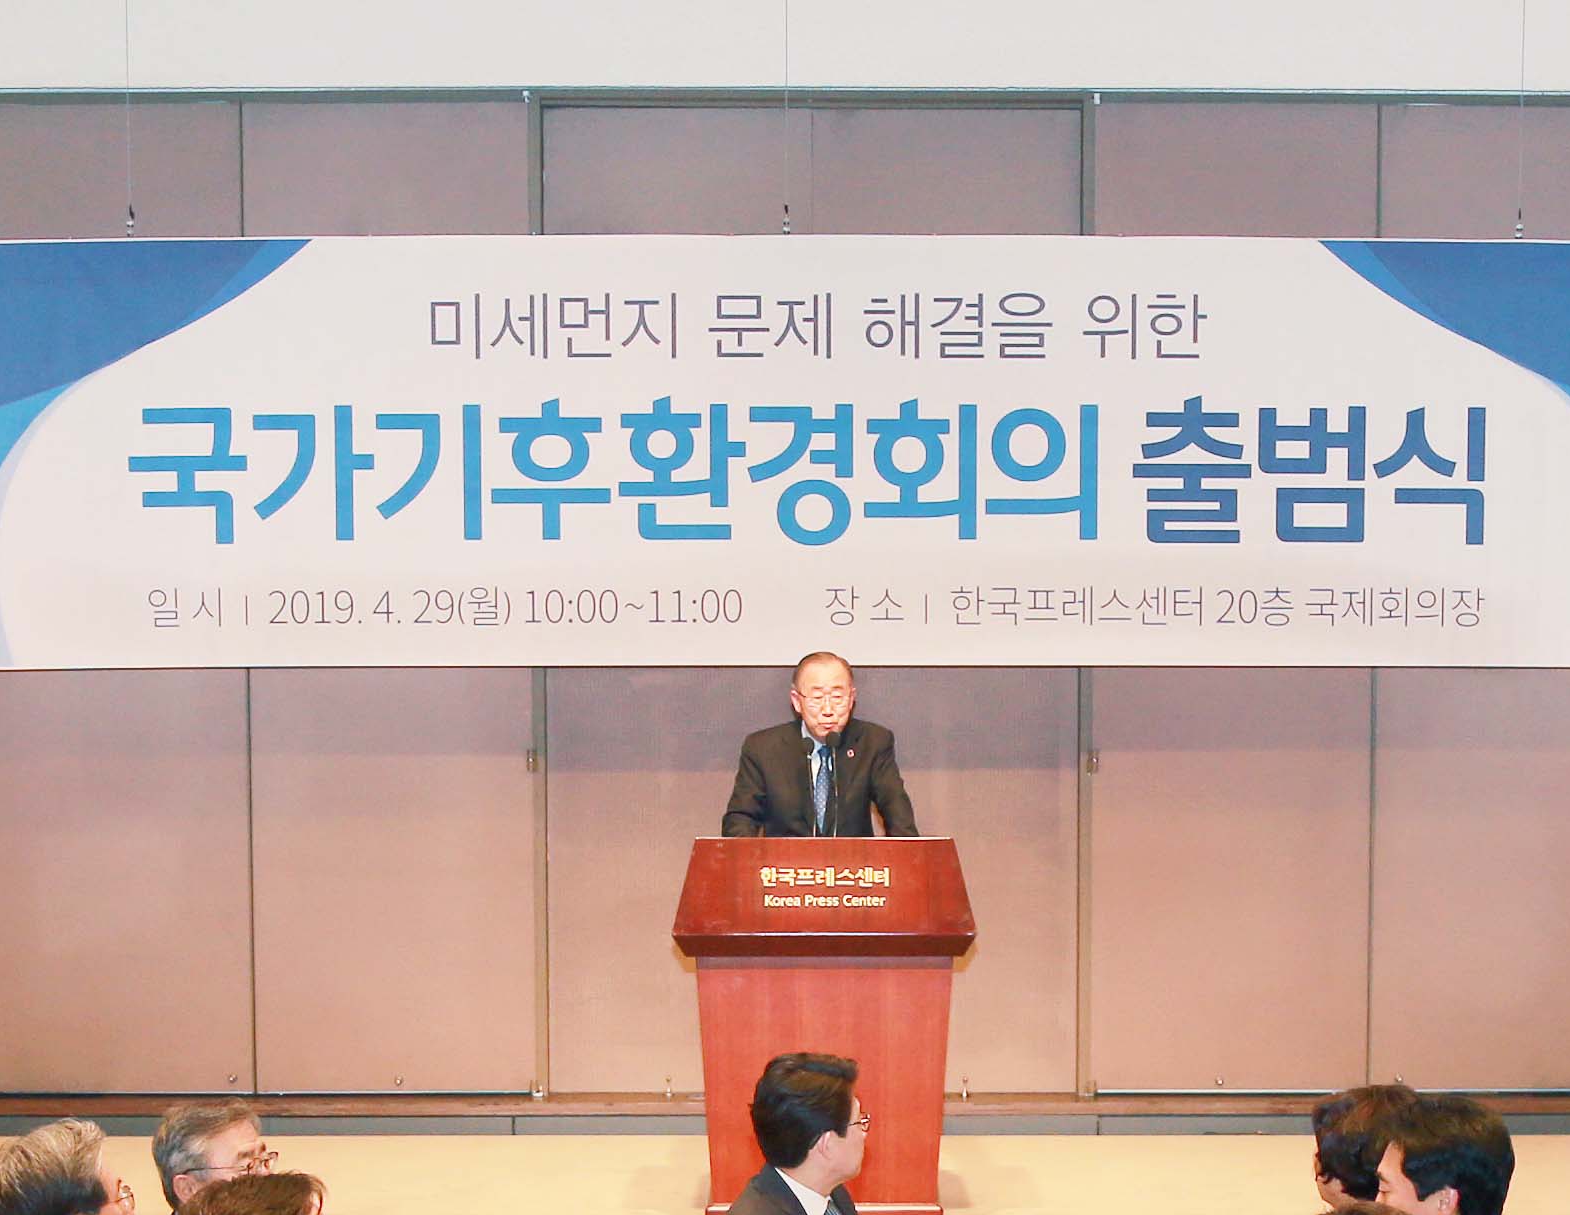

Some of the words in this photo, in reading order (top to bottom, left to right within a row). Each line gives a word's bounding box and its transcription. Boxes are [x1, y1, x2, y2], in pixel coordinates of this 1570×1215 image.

[429, 292, 678, 360] 미세먼지
[708, 292, 833, 360] 문제
[863, 292, 1053, 360] 해결을
[1082, 292, 1208, 360] 위한
[126, 395, 1100, 547] 국가기후환경회의
[1131, 394, 1488, 546] 출범식
[524, 588, 744, 625] 10:00~11:00
[949, 585, 1204, 627] 한국프레스센터
[1214, 585, 1296, 627] 20층
[1304, 586, 1487, 628] 국제회의장
[759, 866, 892, 888] 한국프레스센터
[763, 894, 802, 908] Korea
[804, 894, 840, 908] Press
[843, 894, 887, 908] Center
